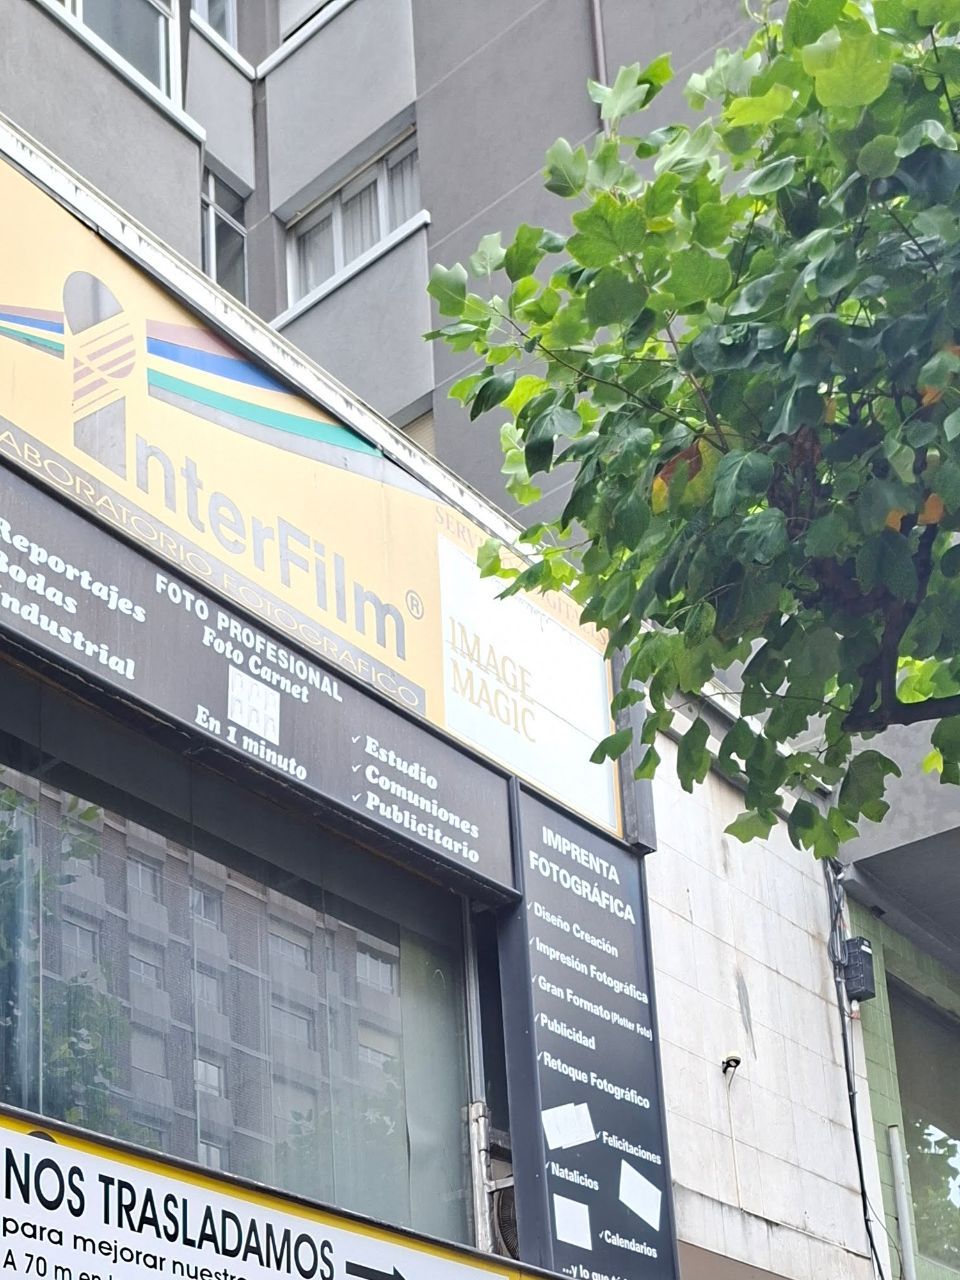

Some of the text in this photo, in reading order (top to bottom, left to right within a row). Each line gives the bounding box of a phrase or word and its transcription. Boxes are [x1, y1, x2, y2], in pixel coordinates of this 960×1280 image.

[155, 573, 343, 702] FOTO PROFESIONAL
[202, 626, 309, 704] Foto Carnet
[224, 574, 420, 707] FOTOGRAFICO
[448, 616, 534, 705] IMAGE
[450, 657, 537, 743] MAGIC
[194, 704, 307, 781] En 1 minuto
[364, 735, 438, 789] Estudio
[365, 764, 479, 839] Comuniones
[366, 790, 480, 863] Publicitario
[542, 826, 620, 885] IMPRENTA
[528, 850, 636, 925] FOTOGRÁFICA
[533, 901, 619, 958] Diseño Creación
[535, 937, 649, 1005] Impresión Fotográfica
[538, 975, 565, 999] Gran
[565, 988, 611, 1021] Formato
[540, 1013, 596, 1050] Publicidad
[543, 1051, 651, 1109] Retoque Fotográfico
[550, 1161, 600, 1191] Natalicios
[602, 1131, 662, 1165] Felicitaciones
[4, 1147, 84, 1217] NOS
[2, 1215, 63, 1246] para
[73, 1235, 167, 1270] mejorar
[3, 1249, 17, 1272] A
[24, 1252, 47, 1278] 70
[579, 1264, 590, 1279] lo
[604, 1230, 658, 1258] Calendarios
